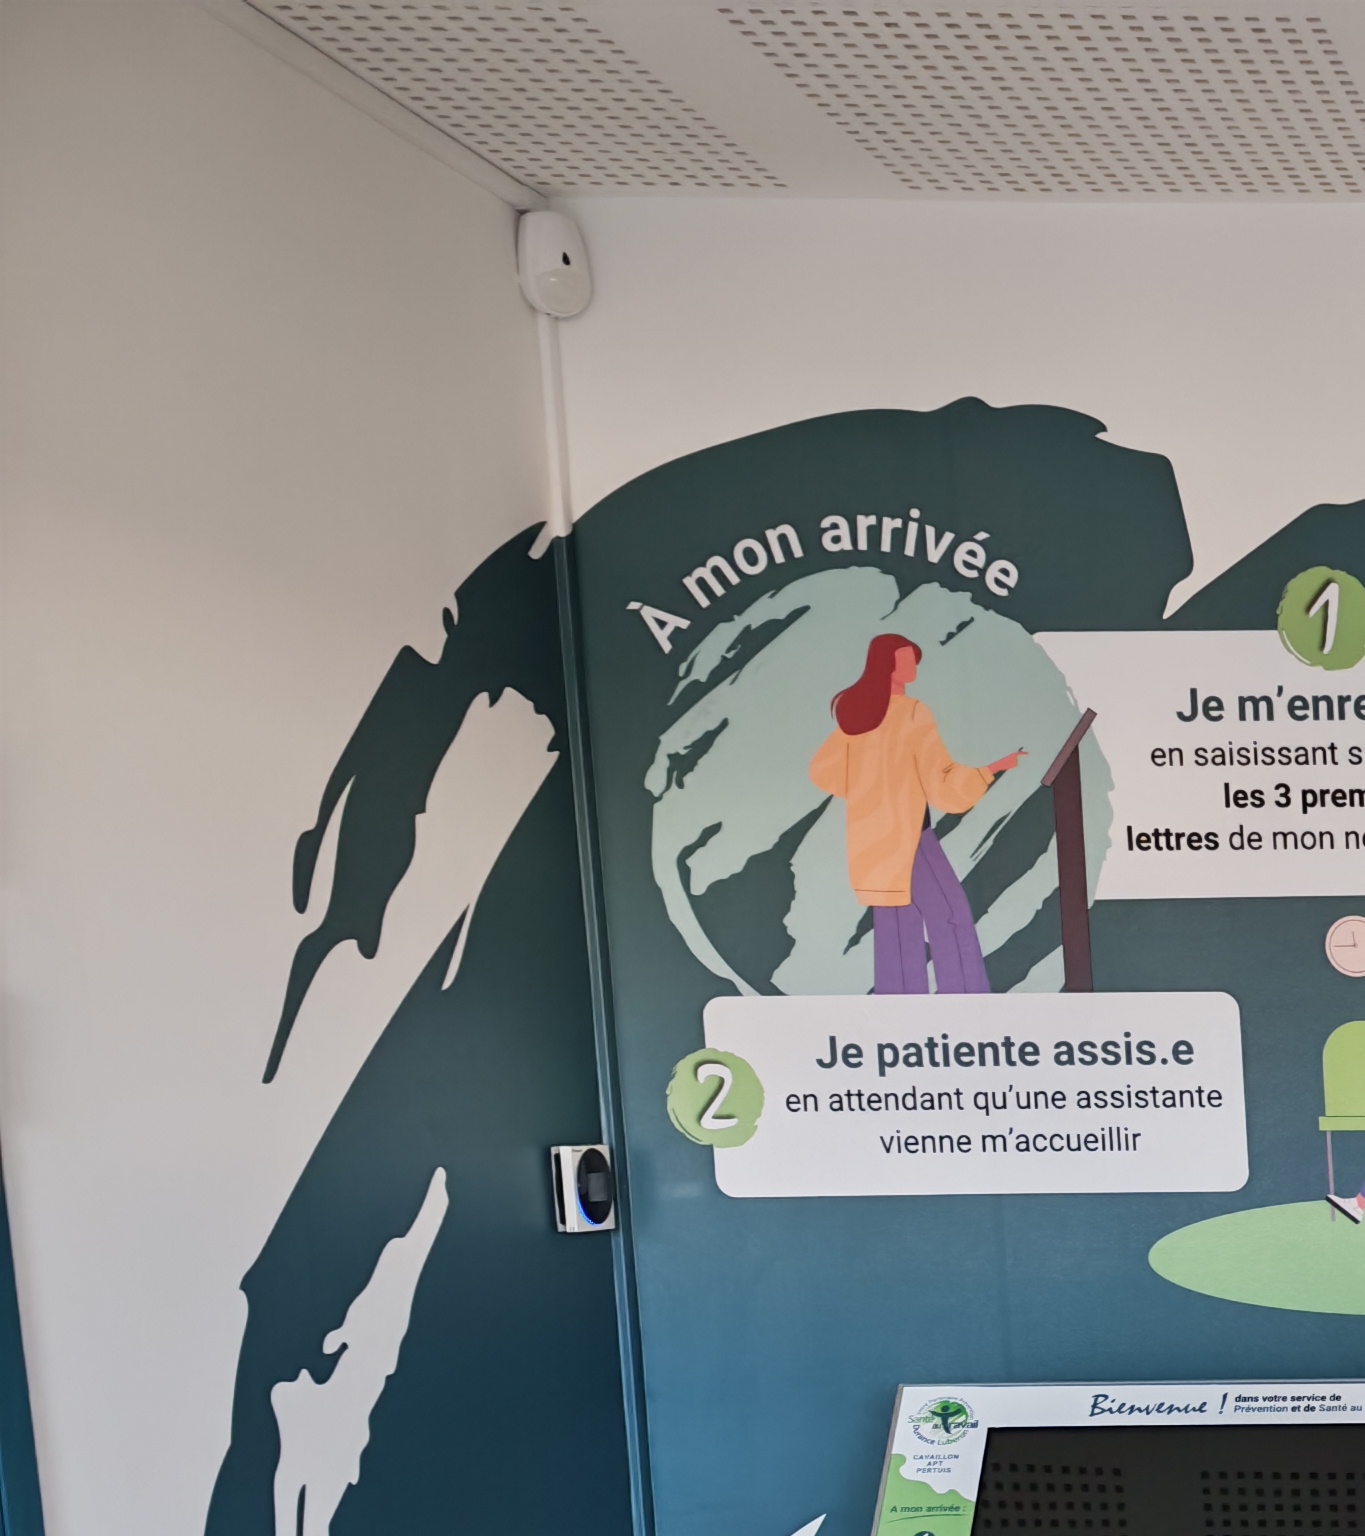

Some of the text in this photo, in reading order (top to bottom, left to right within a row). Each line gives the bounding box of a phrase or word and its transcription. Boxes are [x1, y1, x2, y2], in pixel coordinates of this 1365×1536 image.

[626, 507, 1021, 655] À mon arrivée
[1305, 578, 1343, 655] 1
[1176, 688, 1224, 722] Je
[1151, 748, 1183, 766] en
[1195, 741, 1338, 766] saisissant
[1224, 783, 1265, 808] les
[1274, 783, 1291, 808] 3
[1127, 826, 1219, 851] lettres
[1229, 825, 1262, 850] de
[1273, 831, 1334, 850] mon
[816, 1032, 1194, 1077] Je patiente assis.e
[693, 1061, 736, 1130] 2
[786, 1085, 1222, 1116] en attendant qu'une assistante
[880, 1127, 1141, 1153] vienne m'accueillir
[1088, 1392, 1228, 1417] Bienvenue !
[1235, 1394, 1259, 1402] dans
[1304, 1404, 1316, 1412] de
[925, 1503, 961, 1513] arrivée
